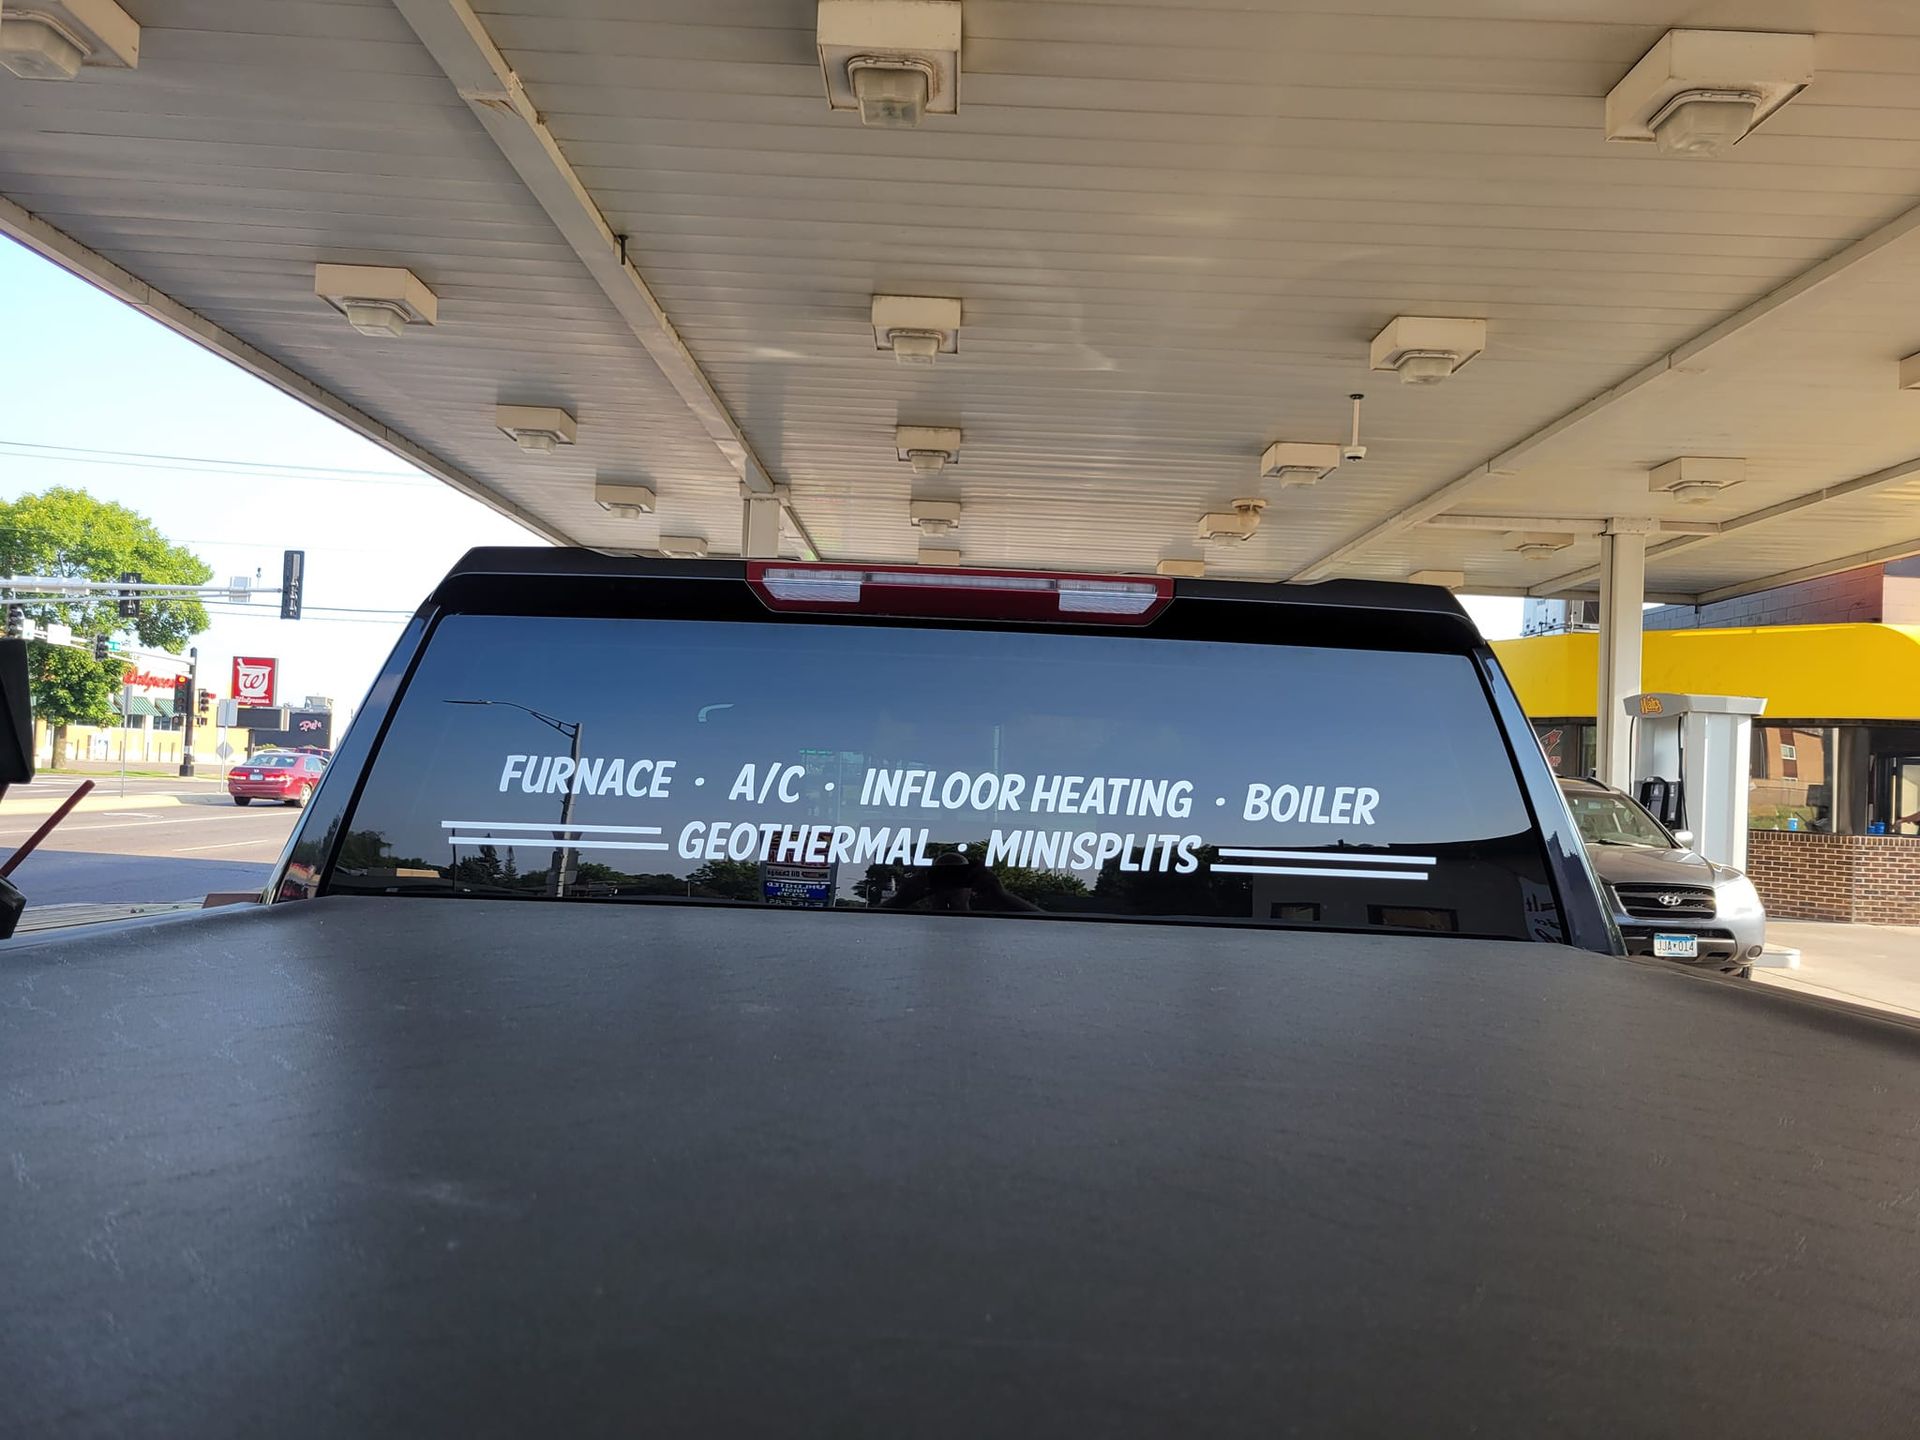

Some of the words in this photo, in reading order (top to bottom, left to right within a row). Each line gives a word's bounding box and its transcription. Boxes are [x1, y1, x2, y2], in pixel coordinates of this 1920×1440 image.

[499, 754, 677, 798] FURNACE
[728, 762, 806, 804] A/C
[860, 767, 1026, 813] INFLOOR
[1029, 774, 1194, 819] HEATING
[1242, 783, 1380, 826] BOILER
[678, 820, 933, 866] GEOTHERMAL
[984, 829, 1203, 874] MINISPLITS
